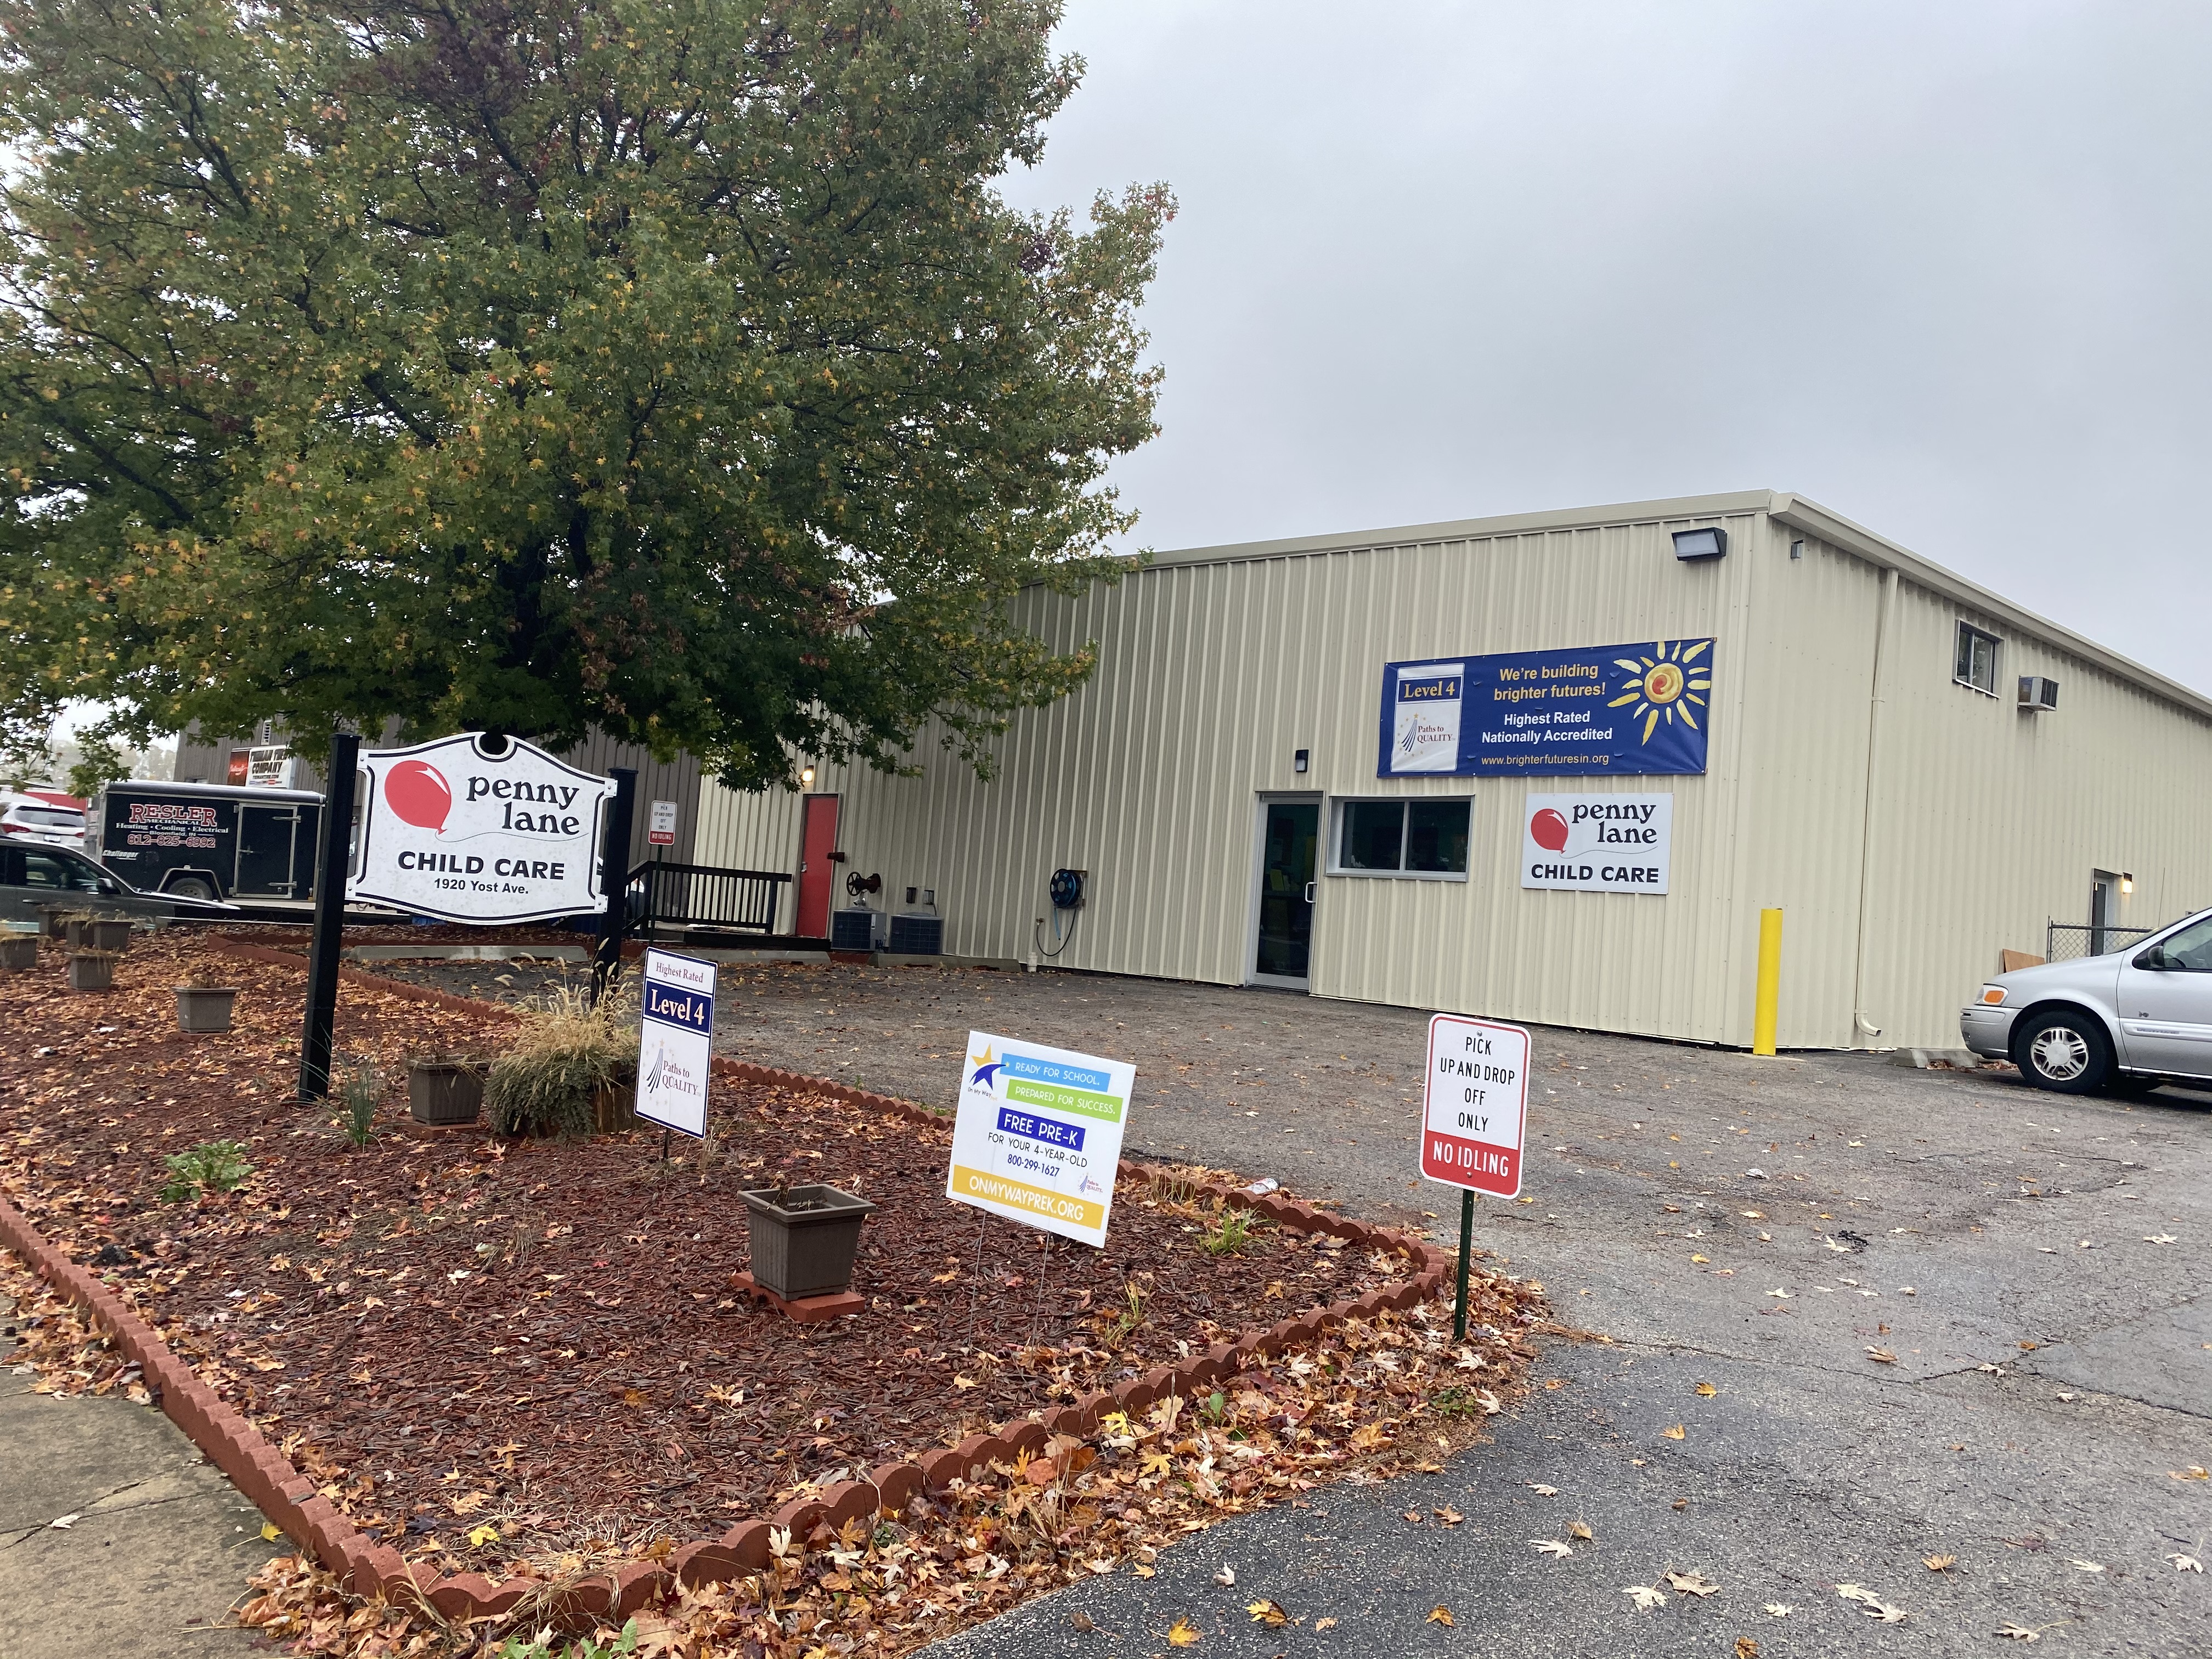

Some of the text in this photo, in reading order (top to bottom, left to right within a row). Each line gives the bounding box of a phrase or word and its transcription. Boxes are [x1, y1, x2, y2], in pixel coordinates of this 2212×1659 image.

[1500, 663, 1599, 681] We're building
[1404, 680, 1455, 698] Level 4
[1494, 682, 1606, 703] brighter futures!
[1504, 710, 1590, 728] Highest Rated
[1482, 727, 1613, 744] Nationally Accredited
[252, 761, 283, 774] COMPANY
[1481, 753, 1609, 767] www.brighterfuturesin.org
[466, 776, 579, 810] penny
[129, 803, 217, 827] RESLER
[502, 802, 579, 835] lane
[1572, 804, 1656, 824] penny
[127, 834, 216, 848] 812-825-6992
[1597, 821, 1657, 844] lane
[398, 851, 565, 880] CHILD CARE
[1531, 864, 1658, 883] CHILD CARE
[435, 878, 528, 894] 1920 Yost Ave.
[656, 962, 704, 983] Highest Rated
[650, 989, 704, 1025] Level 4
[1465, 1036, 1492, 1056] PICK
[663, 1060, 690, 1078] Paths to
[1015, 1062, 1100, 1086] READY FOR SCHOOL.
[1441, 1057, 1515, 1085] UP AND DROP
[1015, 1086, 1116, 1115] PREPARED FOR SUCCESS.
[1465, 1088, 1486, 1105] OFF
[1003, 1114, 1078, 1147] FREE PRE-K
[1458, 1112, 1488, 1132] ONLY
[988, 1132, 1088, 1168] FOR YOUR 4-YEAR-OLD
[1433, 1141, 1509, 1177] NO IDLING
[1007, 1154, 1060, 1177] 800-299-1627
[969, 1176, 1084, 1221] ONMYWAYPREK.ORG
